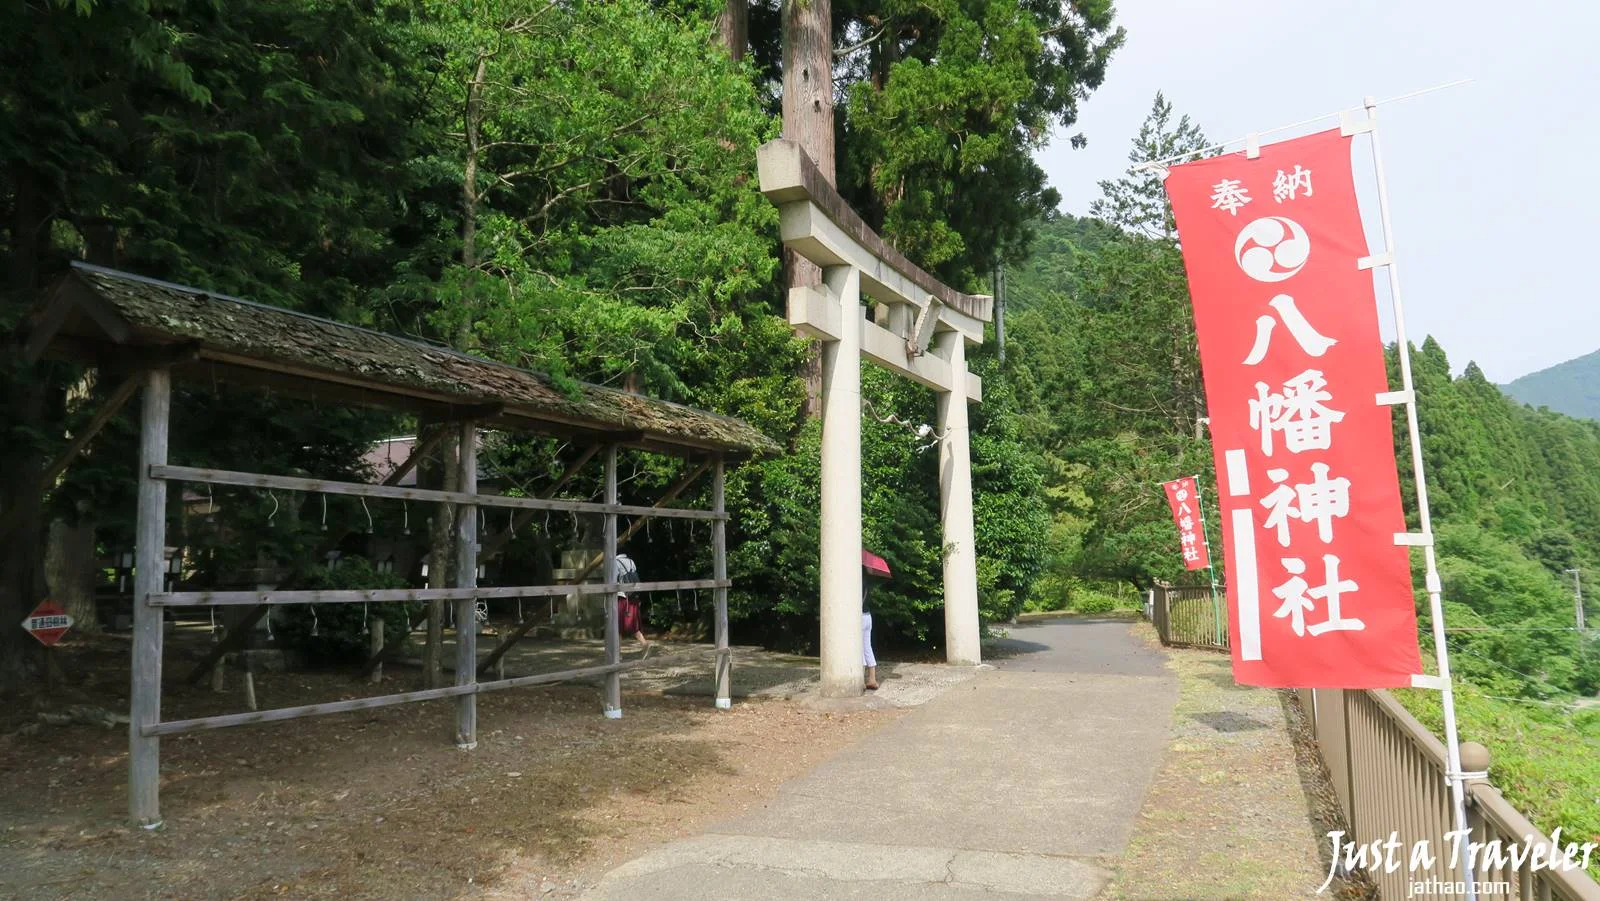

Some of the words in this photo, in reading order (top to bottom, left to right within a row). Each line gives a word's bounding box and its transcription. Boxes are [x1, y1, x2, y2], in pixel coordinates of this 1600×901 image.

[1210, 165, 1313, 216] 奉納
[1243, 294, 1366, 638] 八幡神社
[1178, 502, 1200, 561] 八幡神社
